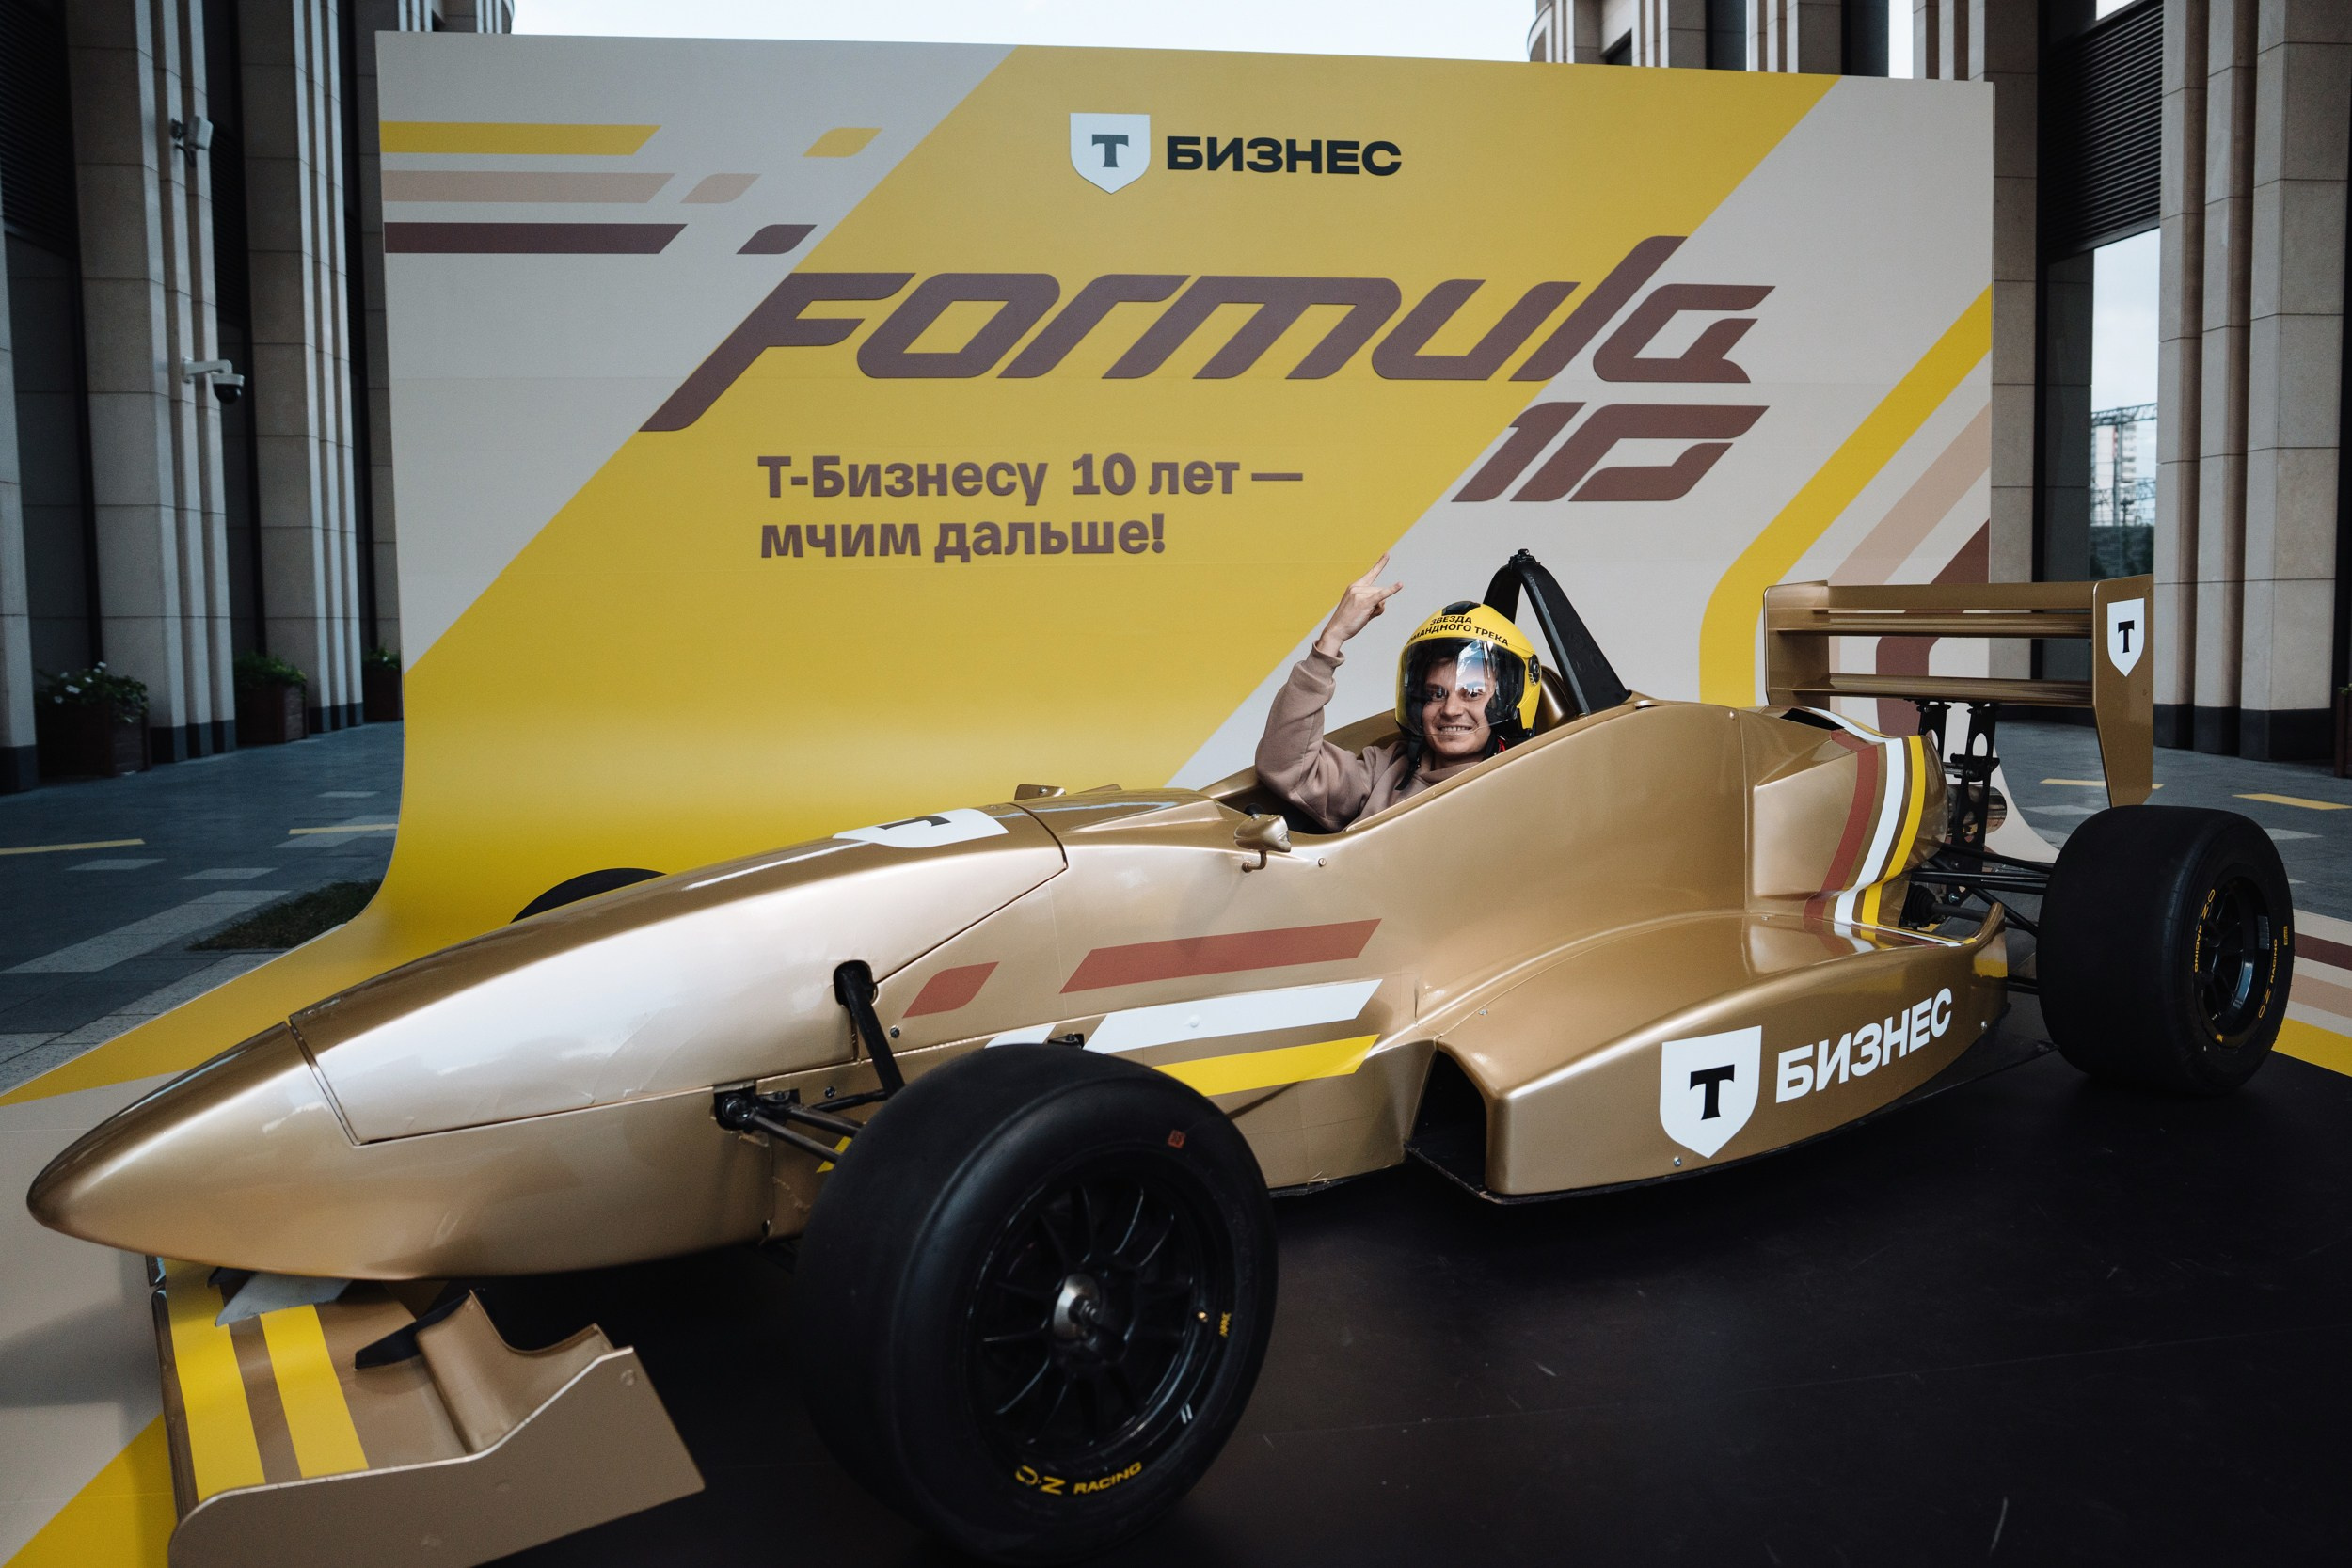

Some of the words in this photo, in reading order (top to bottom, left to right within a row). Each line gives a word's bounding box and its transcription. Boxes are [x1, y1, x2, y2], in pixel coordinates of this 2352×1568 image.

[1167, 135, 1402, 177] БИЗНЕС
[757, 455, 1048, 506] Т-Бизнесу
[1073, 453, 1136, 496] 10
[1148, 460, 1241, 496] лет
[760, 523, 922, 559] мчим
[934, 513, 1166, 563] дальше!
[1430, 615, 1472, 626] ЗВЕЗДА
[1474, 626, 1509, 646] ТРЕКА
[2194, 925, 2202, 973] RACING
[1776, 988, 1952, 1103] БИЗНЕС
[1073, 1461, 1142, 1495] RACING
